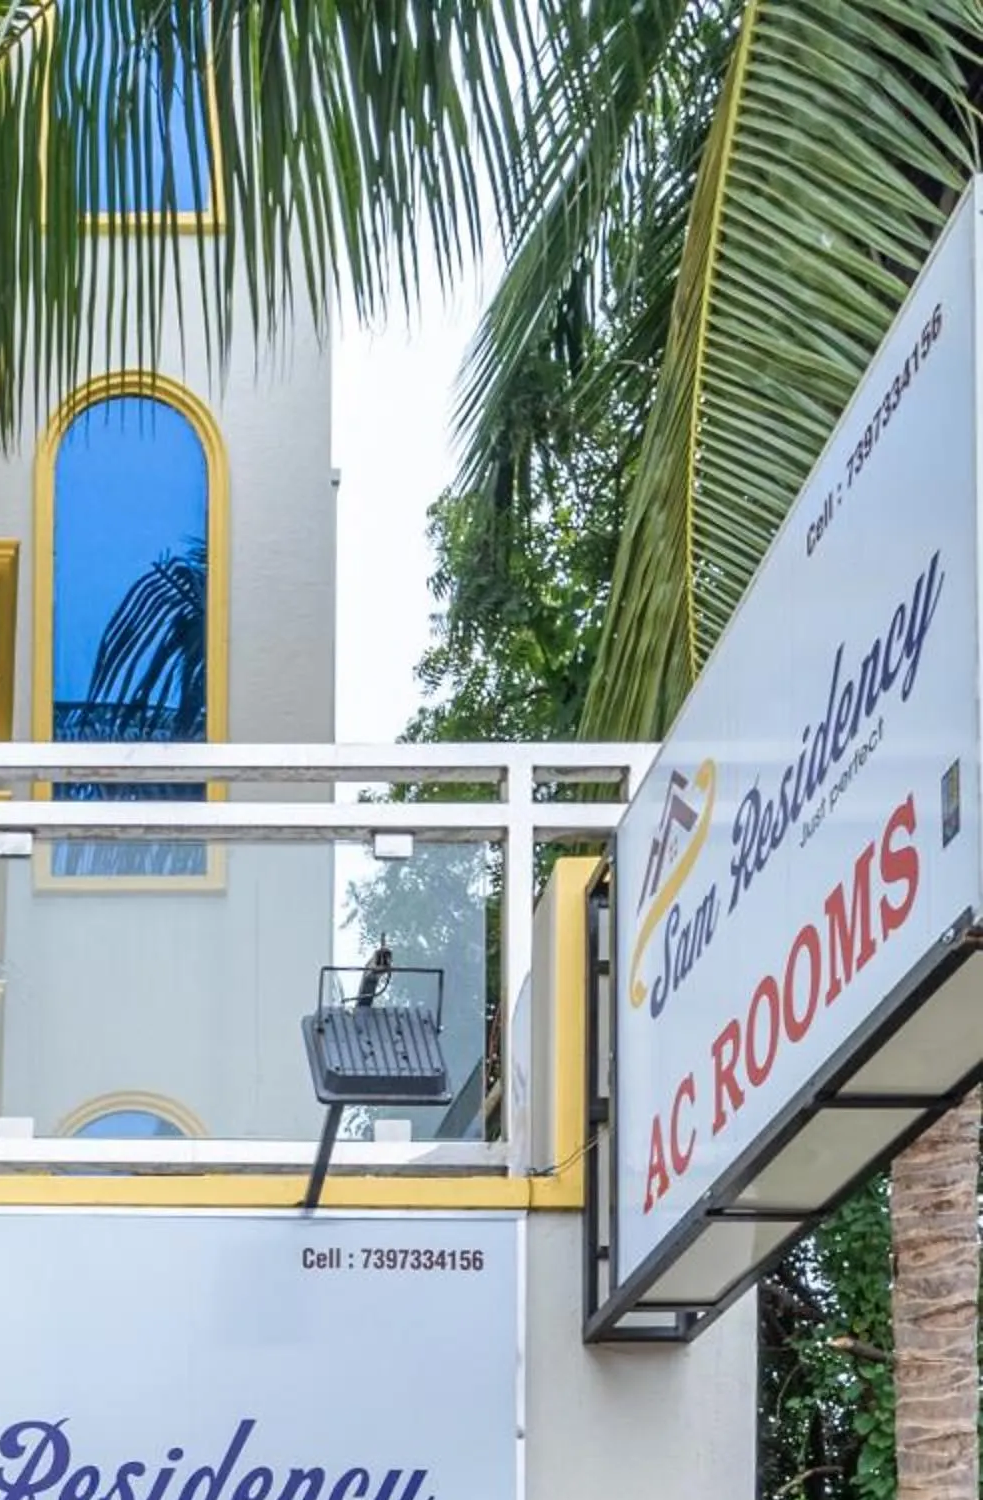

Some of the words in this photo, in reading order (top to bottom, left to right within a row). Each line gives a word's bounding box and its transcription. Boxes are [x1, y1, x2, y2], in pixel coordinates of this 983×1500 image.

[805, 498, 834, 557] Cell
[846, 302, 944, 489] 7397334156
[650, 882, 719, 1018] Sam
[728, 549, 945, 914] Residency
[799, 804, 828, 849] Just
[829, 716, 885, 811] perfect
[644, 1073, 696, 1214] AC
[711, 794, 919, 1136] ROOMS
[302, 1247, 342, 1270] Cell
[360, 1247, 485, 1272] 7397334156
